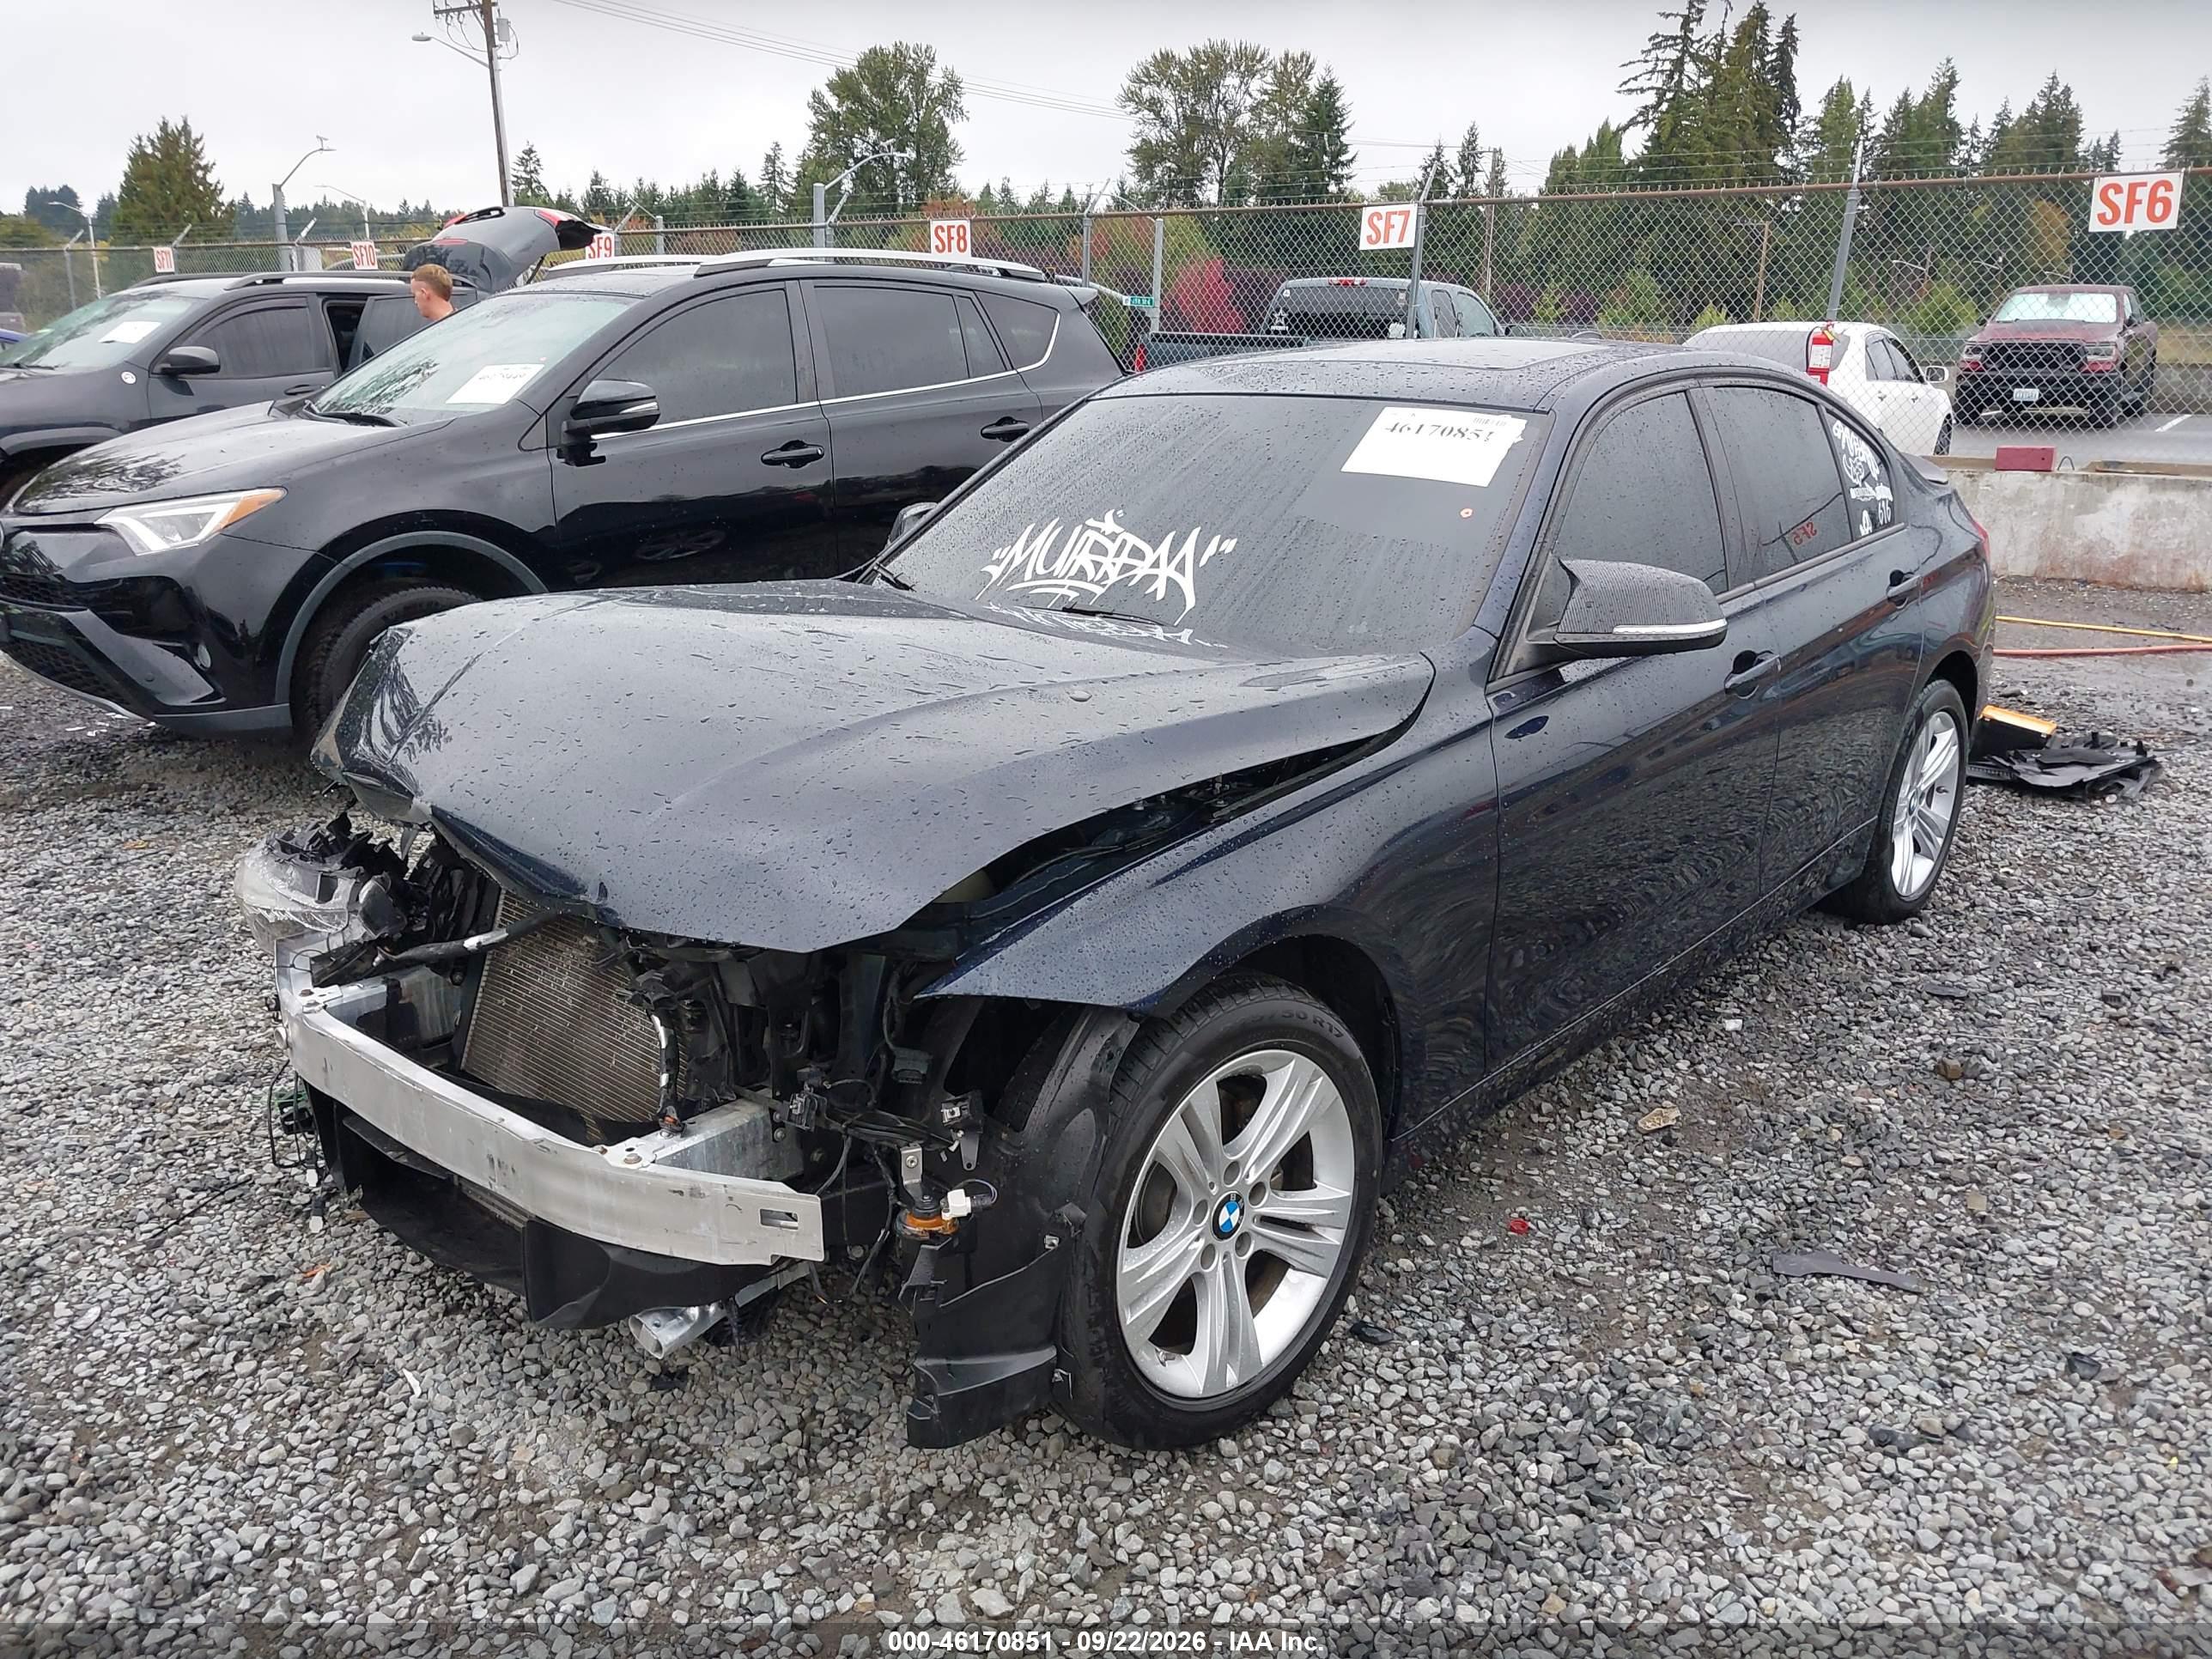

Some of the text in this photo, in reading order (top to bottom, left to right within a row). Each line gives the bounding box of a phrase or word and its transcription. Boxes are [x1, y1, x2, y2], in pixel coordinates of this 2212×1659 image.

[2097, 179, 2173, 225] SF6
[934, 224, 967, 253] SF8
[1367, 210, 1410, 245] SF7
[156, 250, 173, 269] SF11
[353, 245, 375, 266] SF10
[1878, 500, 1891, 526] 616
